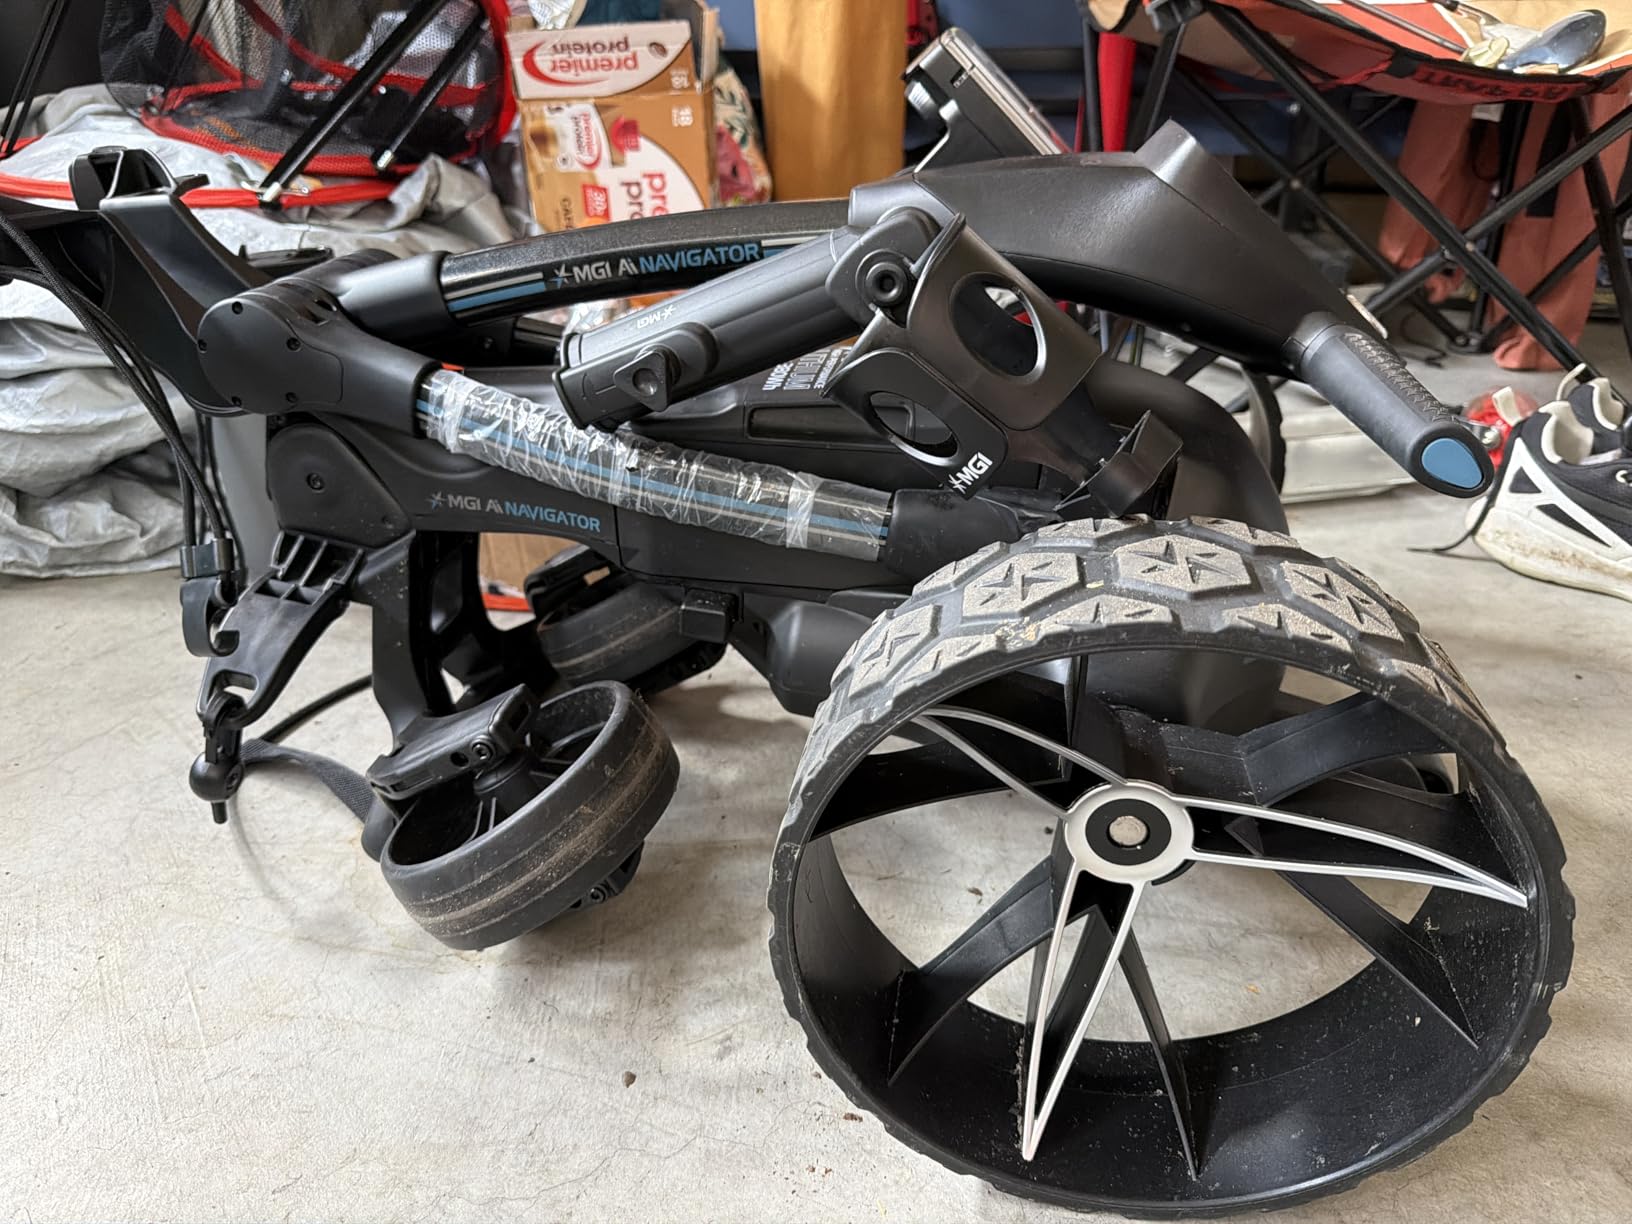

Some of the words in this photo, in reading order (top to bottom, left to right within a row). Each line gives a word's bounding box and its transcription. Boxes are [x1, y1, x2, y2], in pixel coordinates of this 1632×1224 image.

[551, 35, 630, 58] protein
[550, 51, 639, 77] premier
[571, 261, 613, 284] MGI
[638, 242, 761, 274] NAVIGATOR
[636, 311, 661, 329] MGI
[956, 451, 993, 486] MGI
[447, 494, 482, 511] MGI
[503, 500, 601, 533] NAVIGATOR
